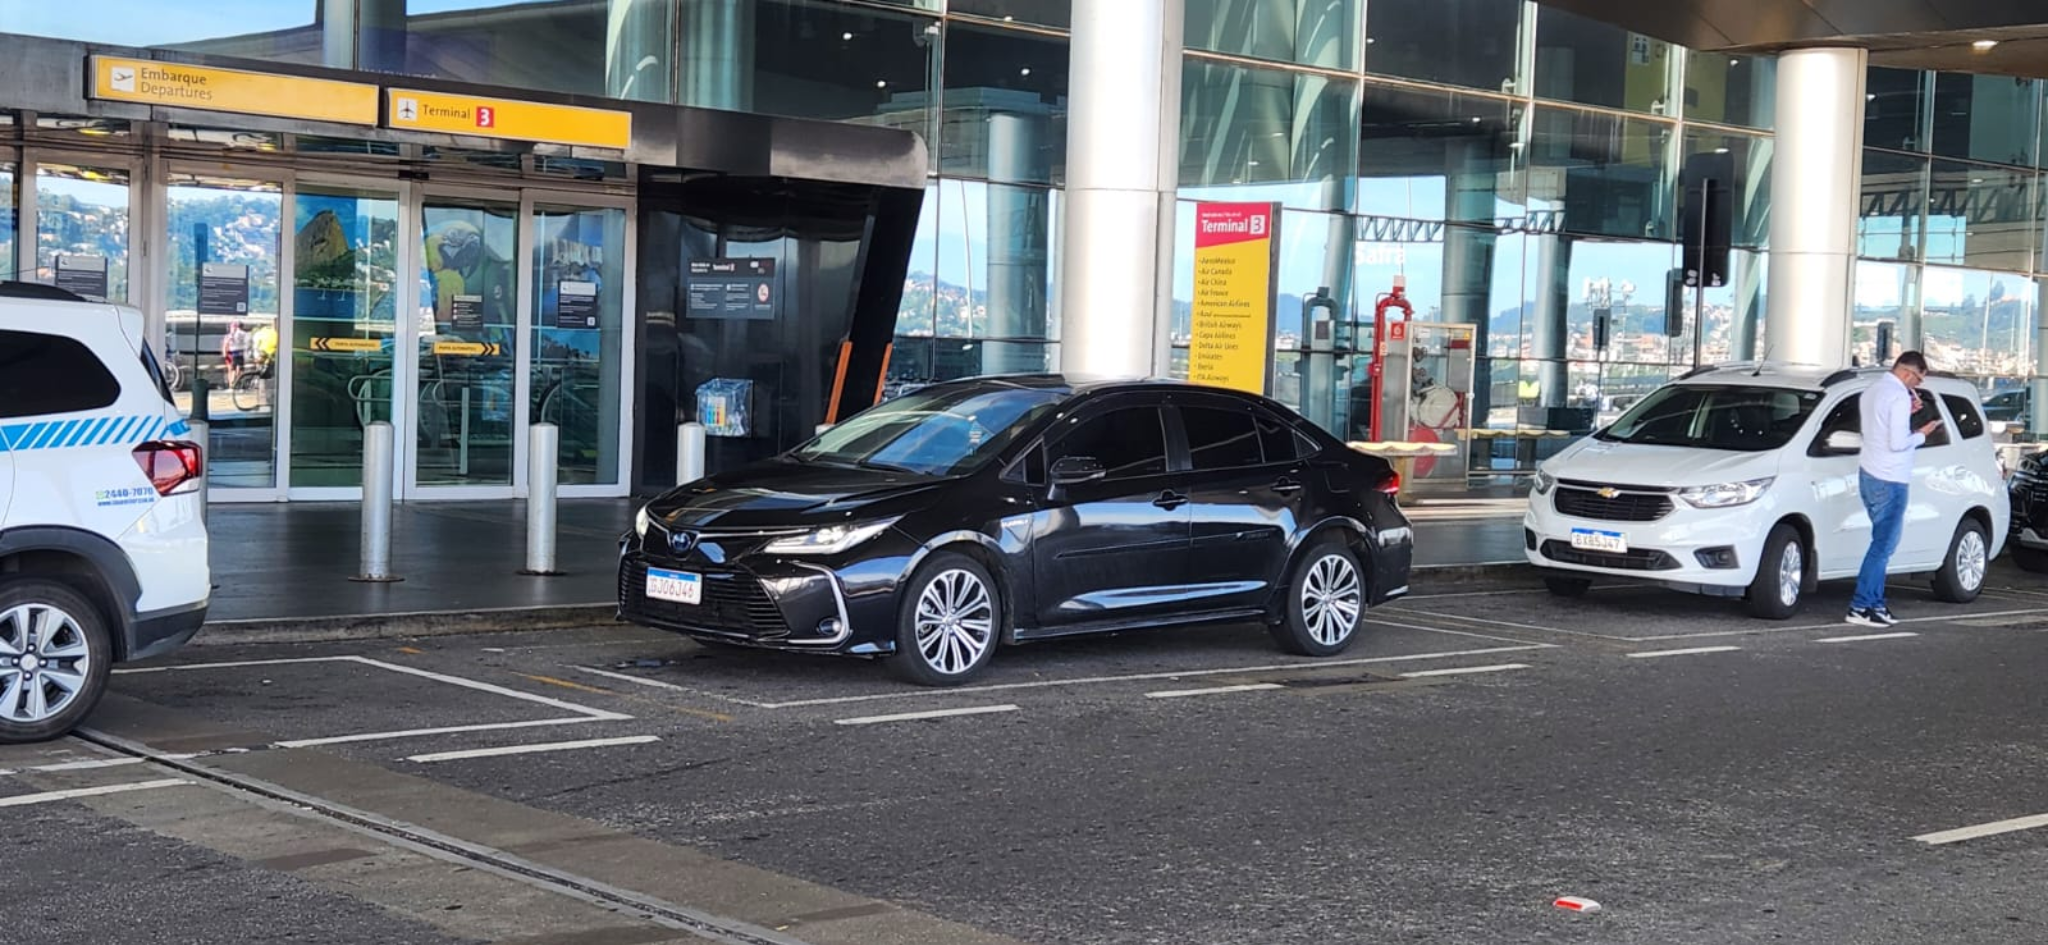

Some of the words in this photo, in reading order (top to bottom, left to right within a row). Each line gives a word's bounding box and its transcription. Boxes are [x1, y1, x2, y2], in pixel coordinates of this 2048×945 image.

[141, 68, 207, 86] Embarque
[141, 82, 212, 100] Departures
[423, 104, 470, 119] Terminal
[481, 108, 490, 126] 3
[1202, 219, 1248, 233] Terminal
[1253, 217, 1262, 232] 3
[1200, 278, 1209, 286] Air
[1210, 278, 1227, 286] China
